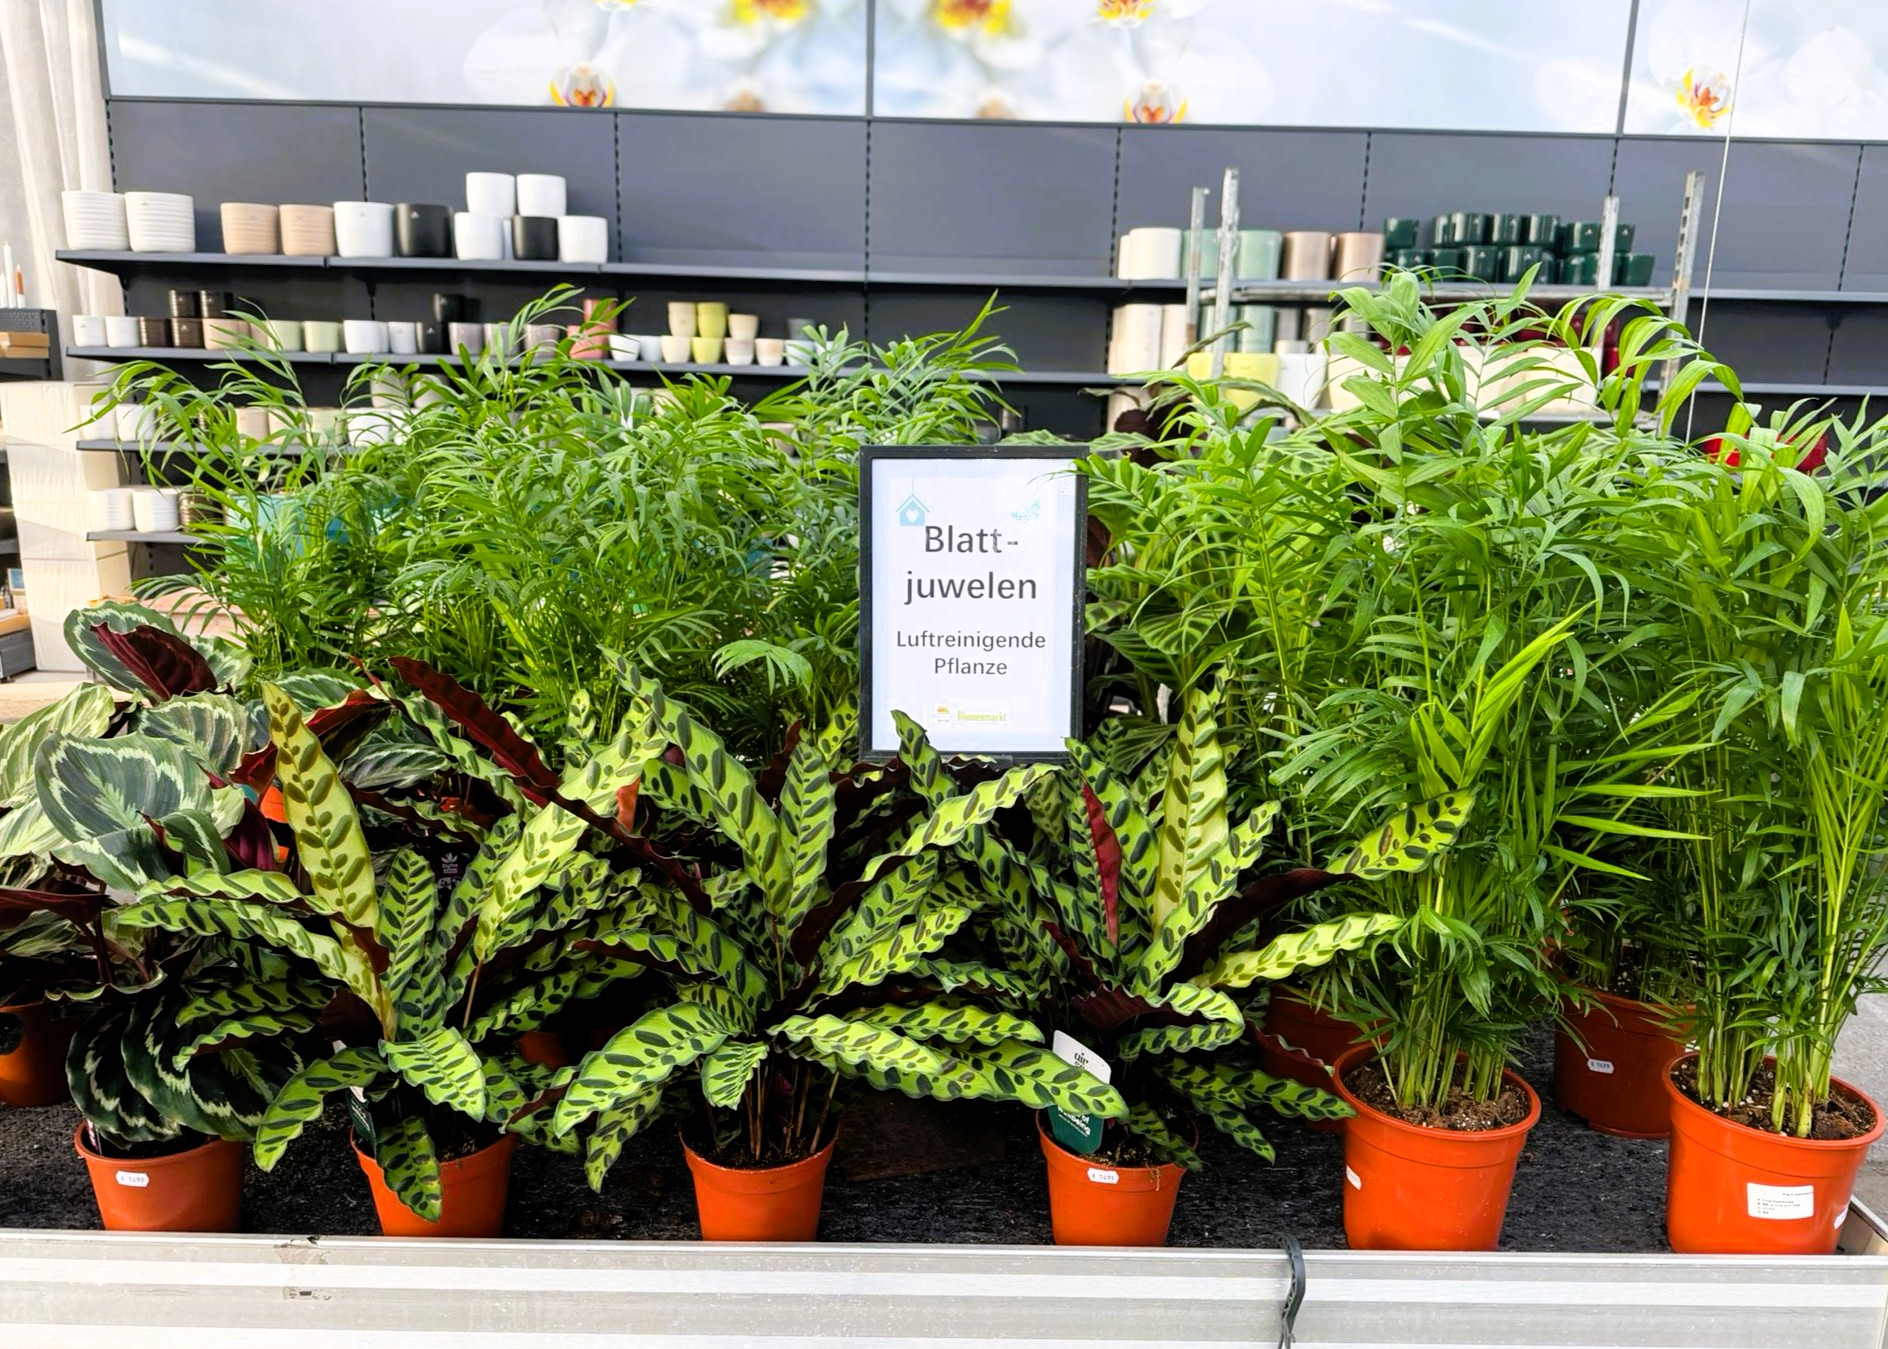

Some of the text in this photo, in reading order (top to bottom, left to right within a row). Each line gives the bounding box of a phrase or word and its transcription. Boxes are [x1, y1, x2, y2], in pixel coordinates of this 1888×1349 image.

[925, 525, 1019, 553] Blatt-
[904, 571, 1036, 605] juwelen
[897, 631, 1045, 651] Luftreinigende
[935, 657, 1007, 674] Pflanze
[1074, 1052, 1089, 1065] air
